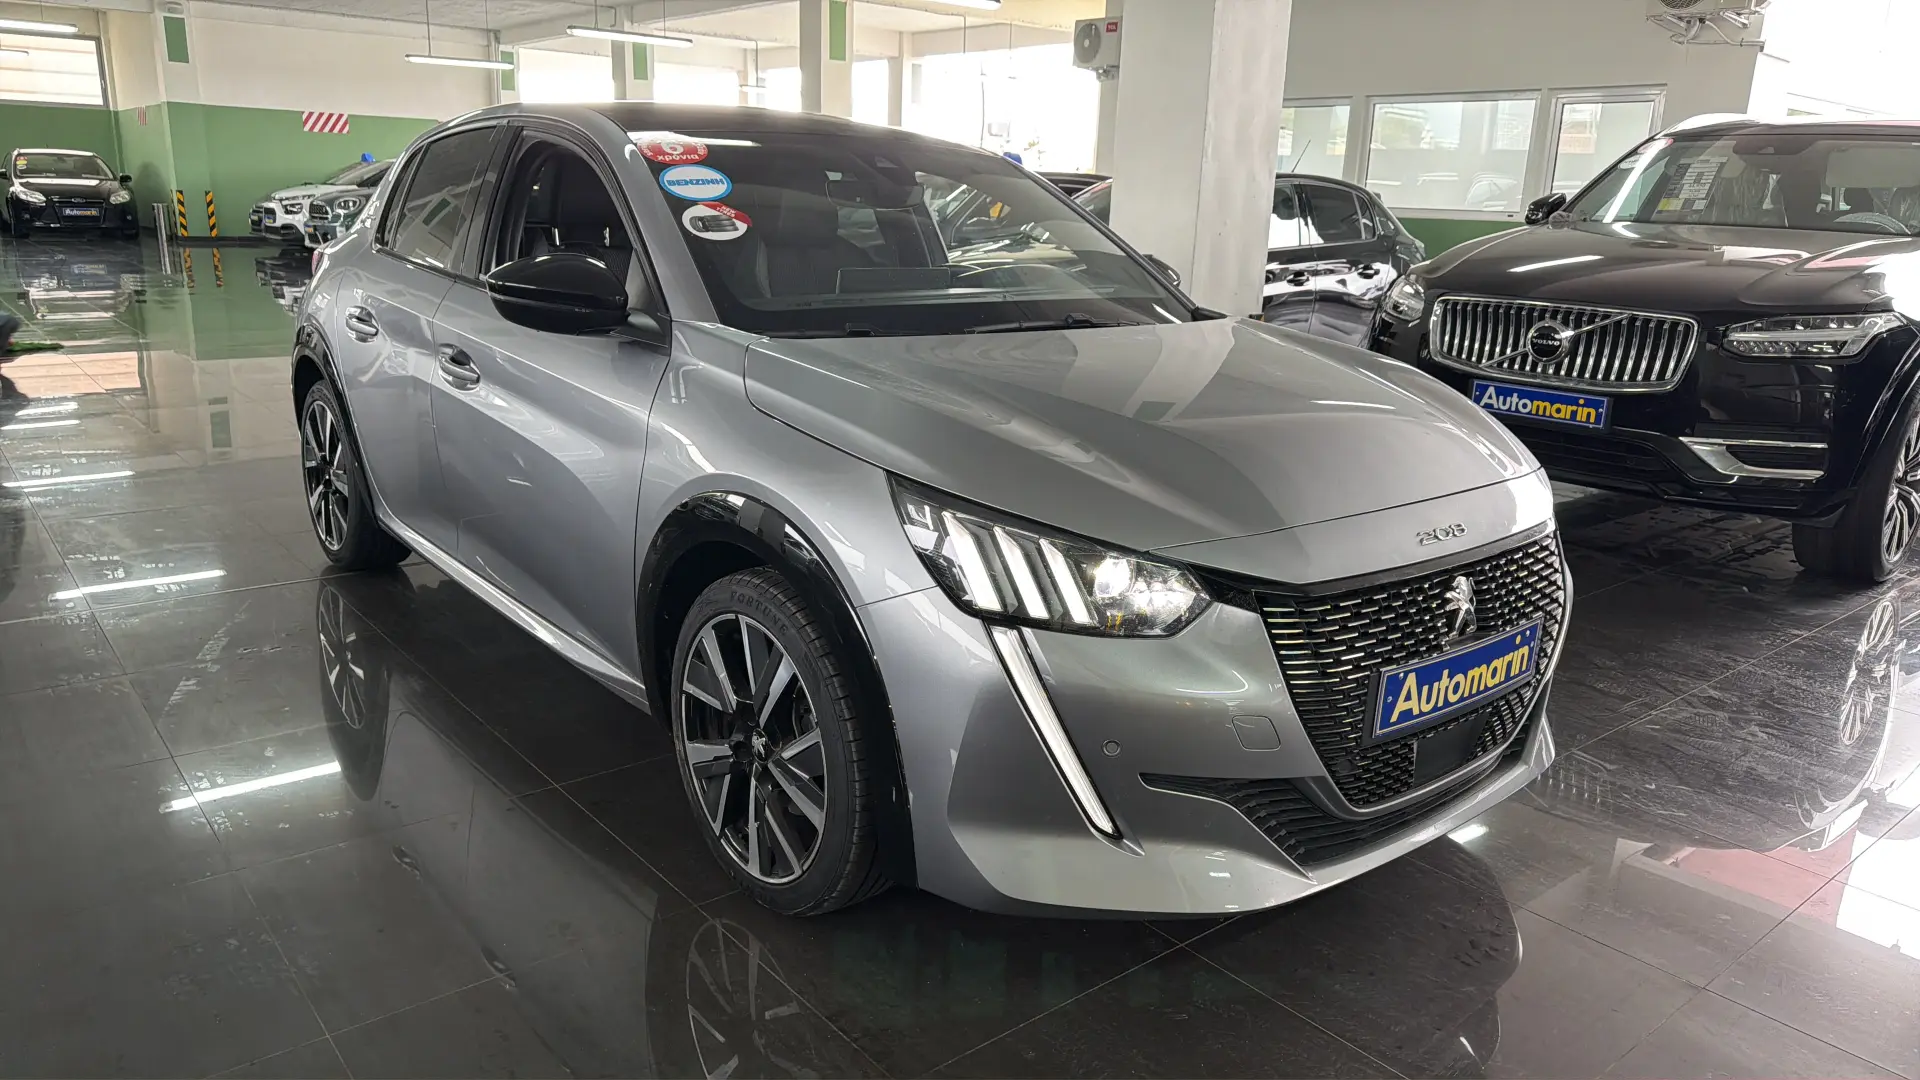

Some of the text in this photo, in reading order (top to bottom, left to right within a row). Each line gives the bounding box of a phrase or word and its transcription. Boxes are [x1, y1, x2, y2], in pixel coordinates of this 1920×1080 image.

[1531, 338, 1561, 346] VOLVO
[1479, 386, 1596, 424] Automarin
[1416, 522, 1468, 546] 208
[1389, 634, 1530, 723] Automarin
